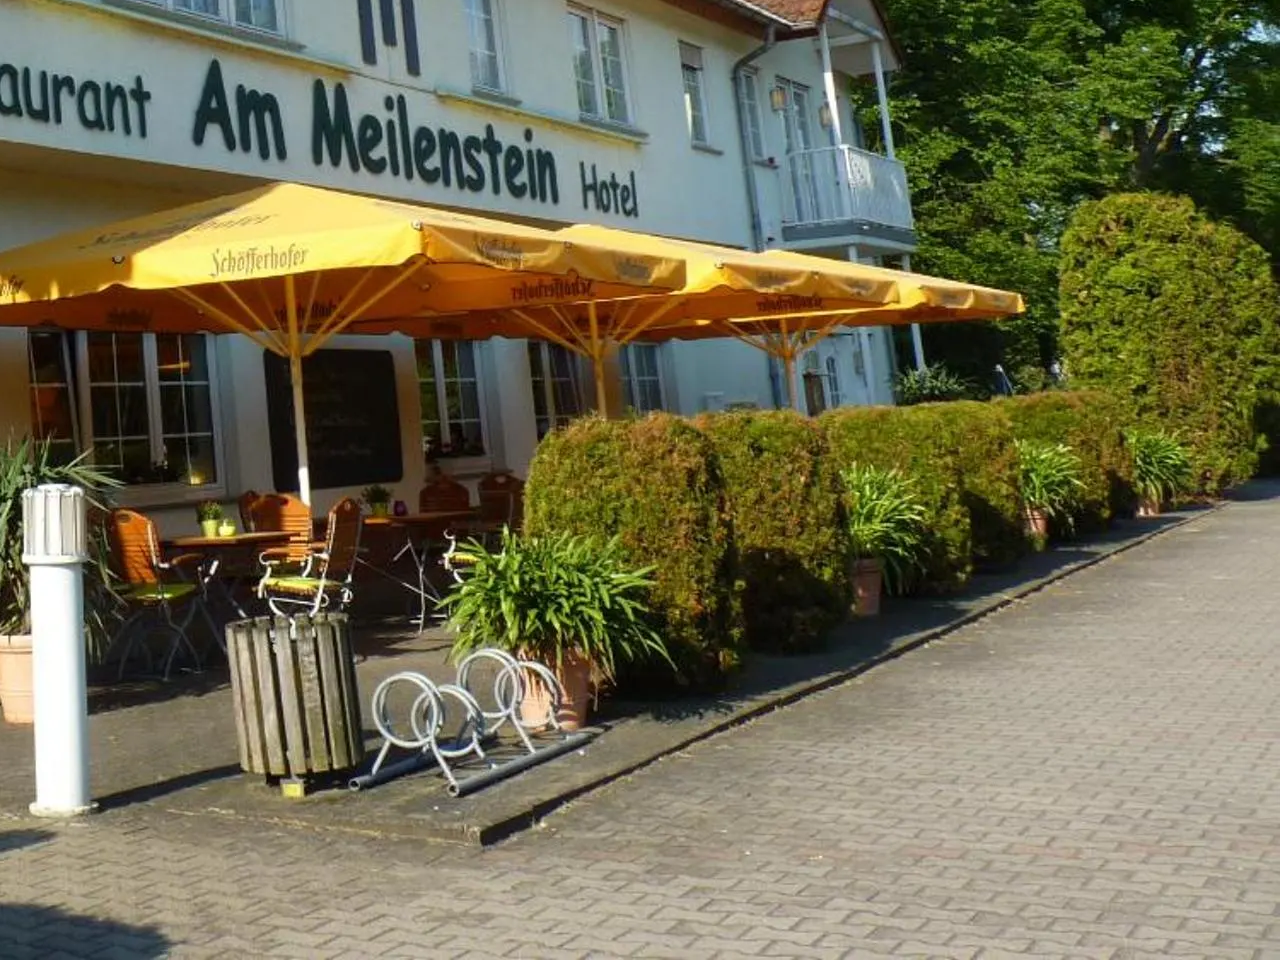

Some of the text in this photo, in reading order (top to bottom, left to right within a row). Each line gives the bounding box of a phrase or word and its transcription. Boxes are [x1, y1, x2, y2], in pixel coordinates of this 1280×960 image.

[193, 57, 288, 162] Am
[311, 77, 560, 205] Meilenstein
[578, 160, 640, 219] Hotel
[208, 243, 310, 278] Schöfferhofer
